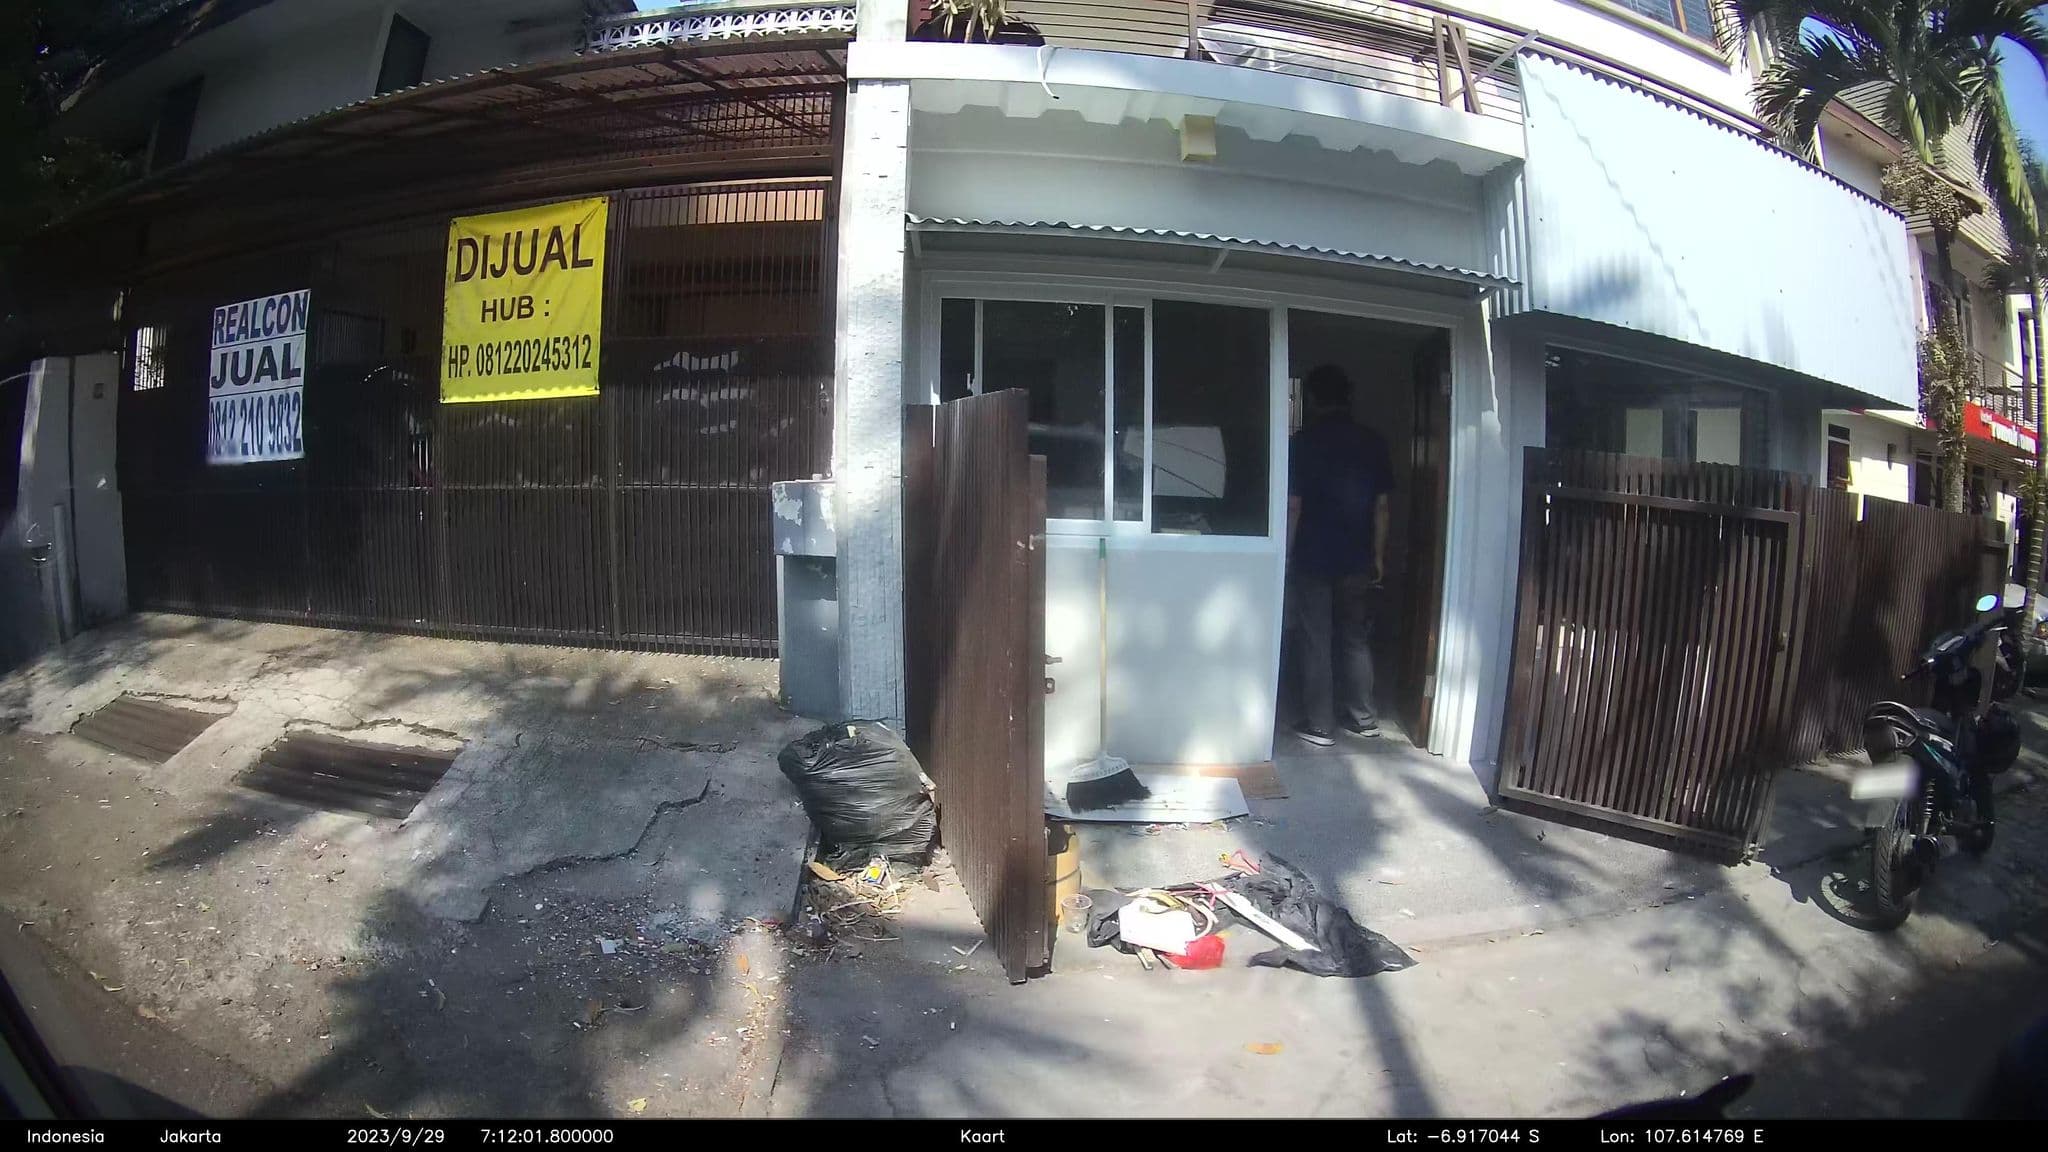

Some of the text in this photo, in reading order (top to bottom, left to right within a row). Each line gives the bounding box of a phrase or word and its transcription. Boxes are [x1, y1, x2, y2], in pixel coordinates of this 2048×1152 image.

[454, 223, 594, 283] DIJUAL
[214, 292, 308, 346] REALCON
[481, 295, 535, 323] HUB
[210, 342, 301, 389] JUAL
[448, 334, 592, 379] HP. 081220245312
[241, 396, 264, 456] 210
[267, 391, 302, 454] 9832
